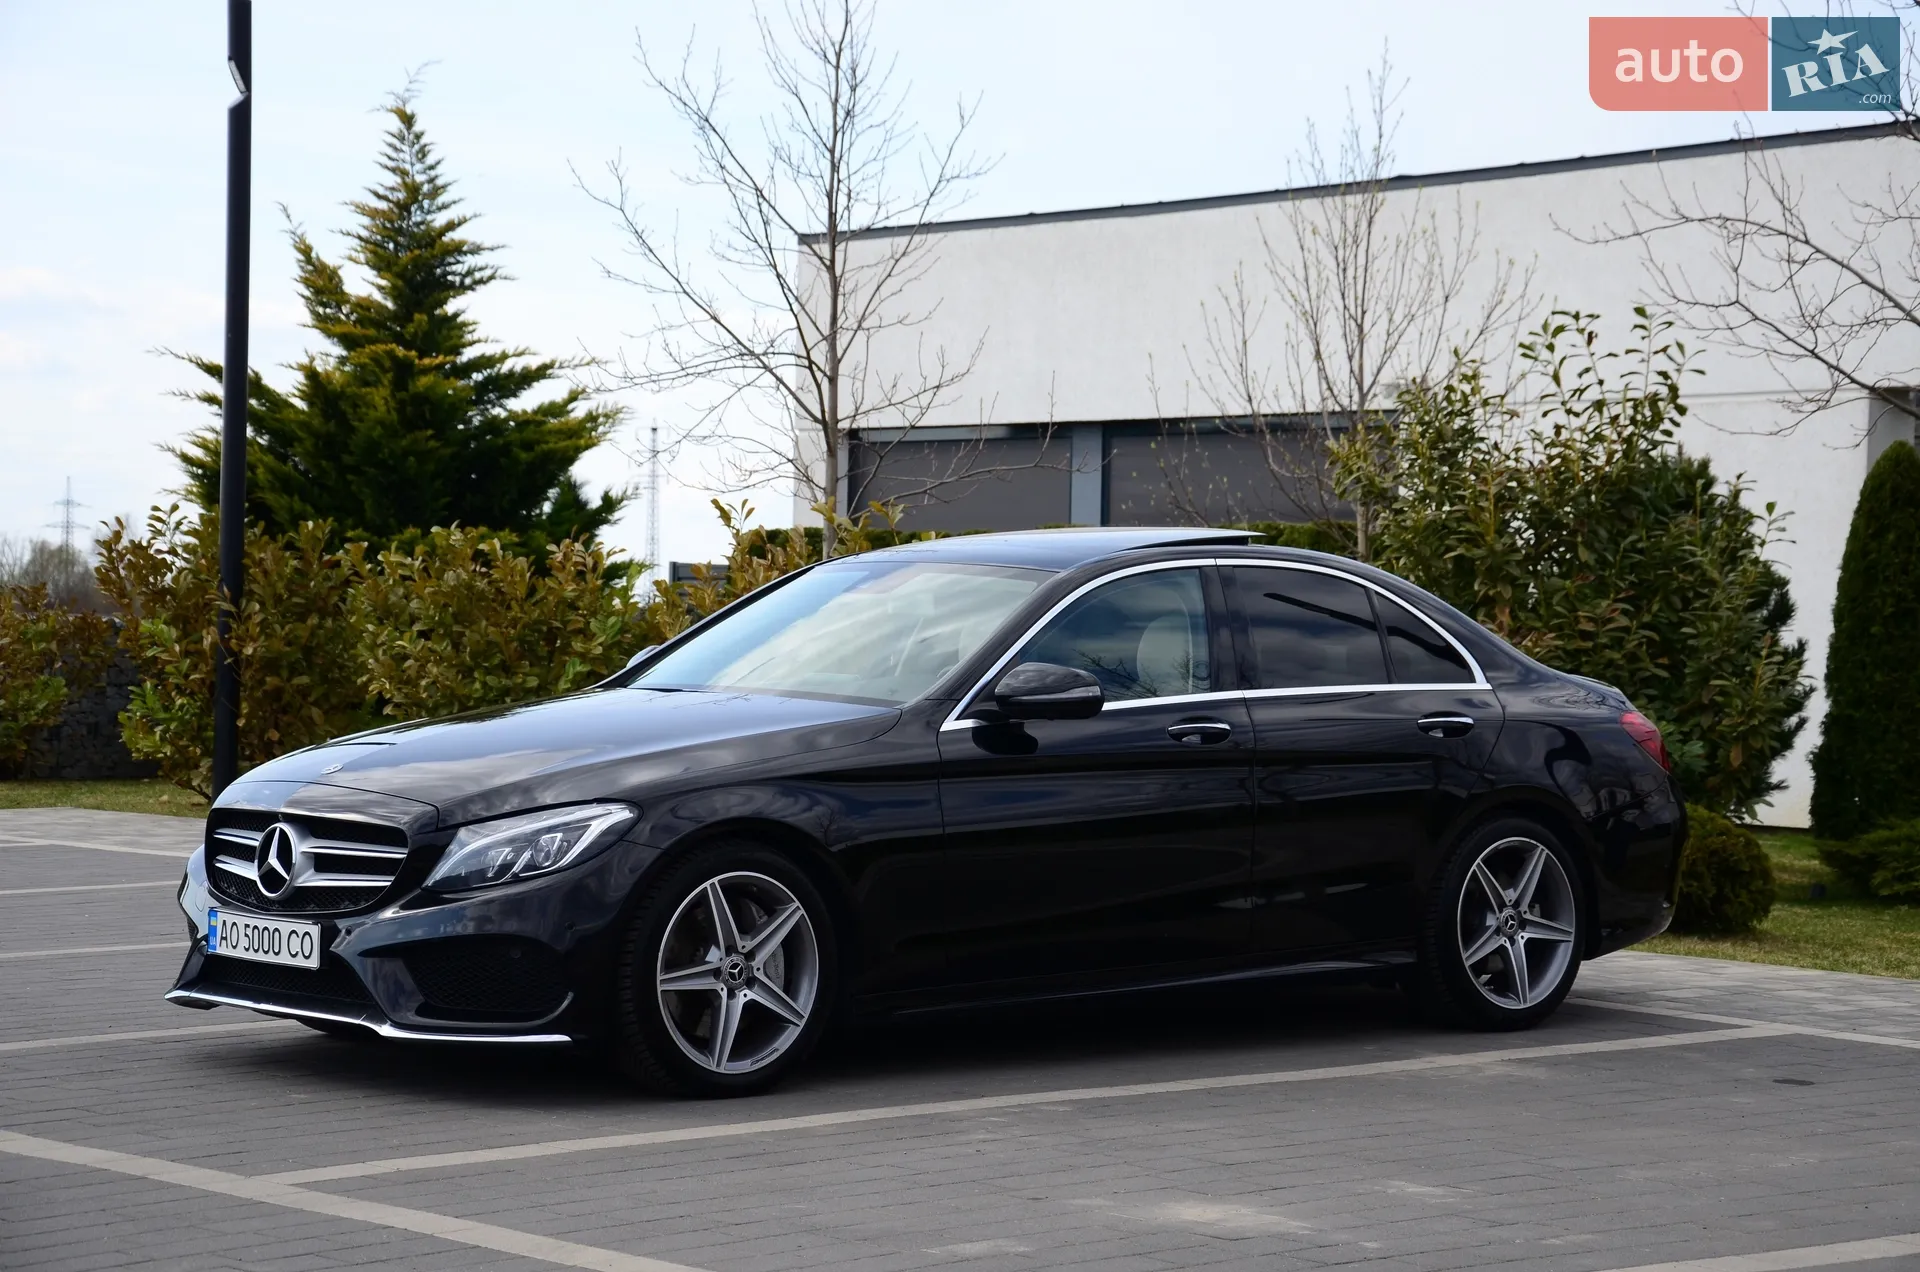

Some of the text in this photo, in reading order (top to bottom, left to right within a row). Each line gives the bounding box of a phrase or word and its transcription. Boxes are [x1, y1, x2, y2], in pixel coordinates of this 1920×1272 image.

[219, 920, 314, 960] AO 5000 CO
